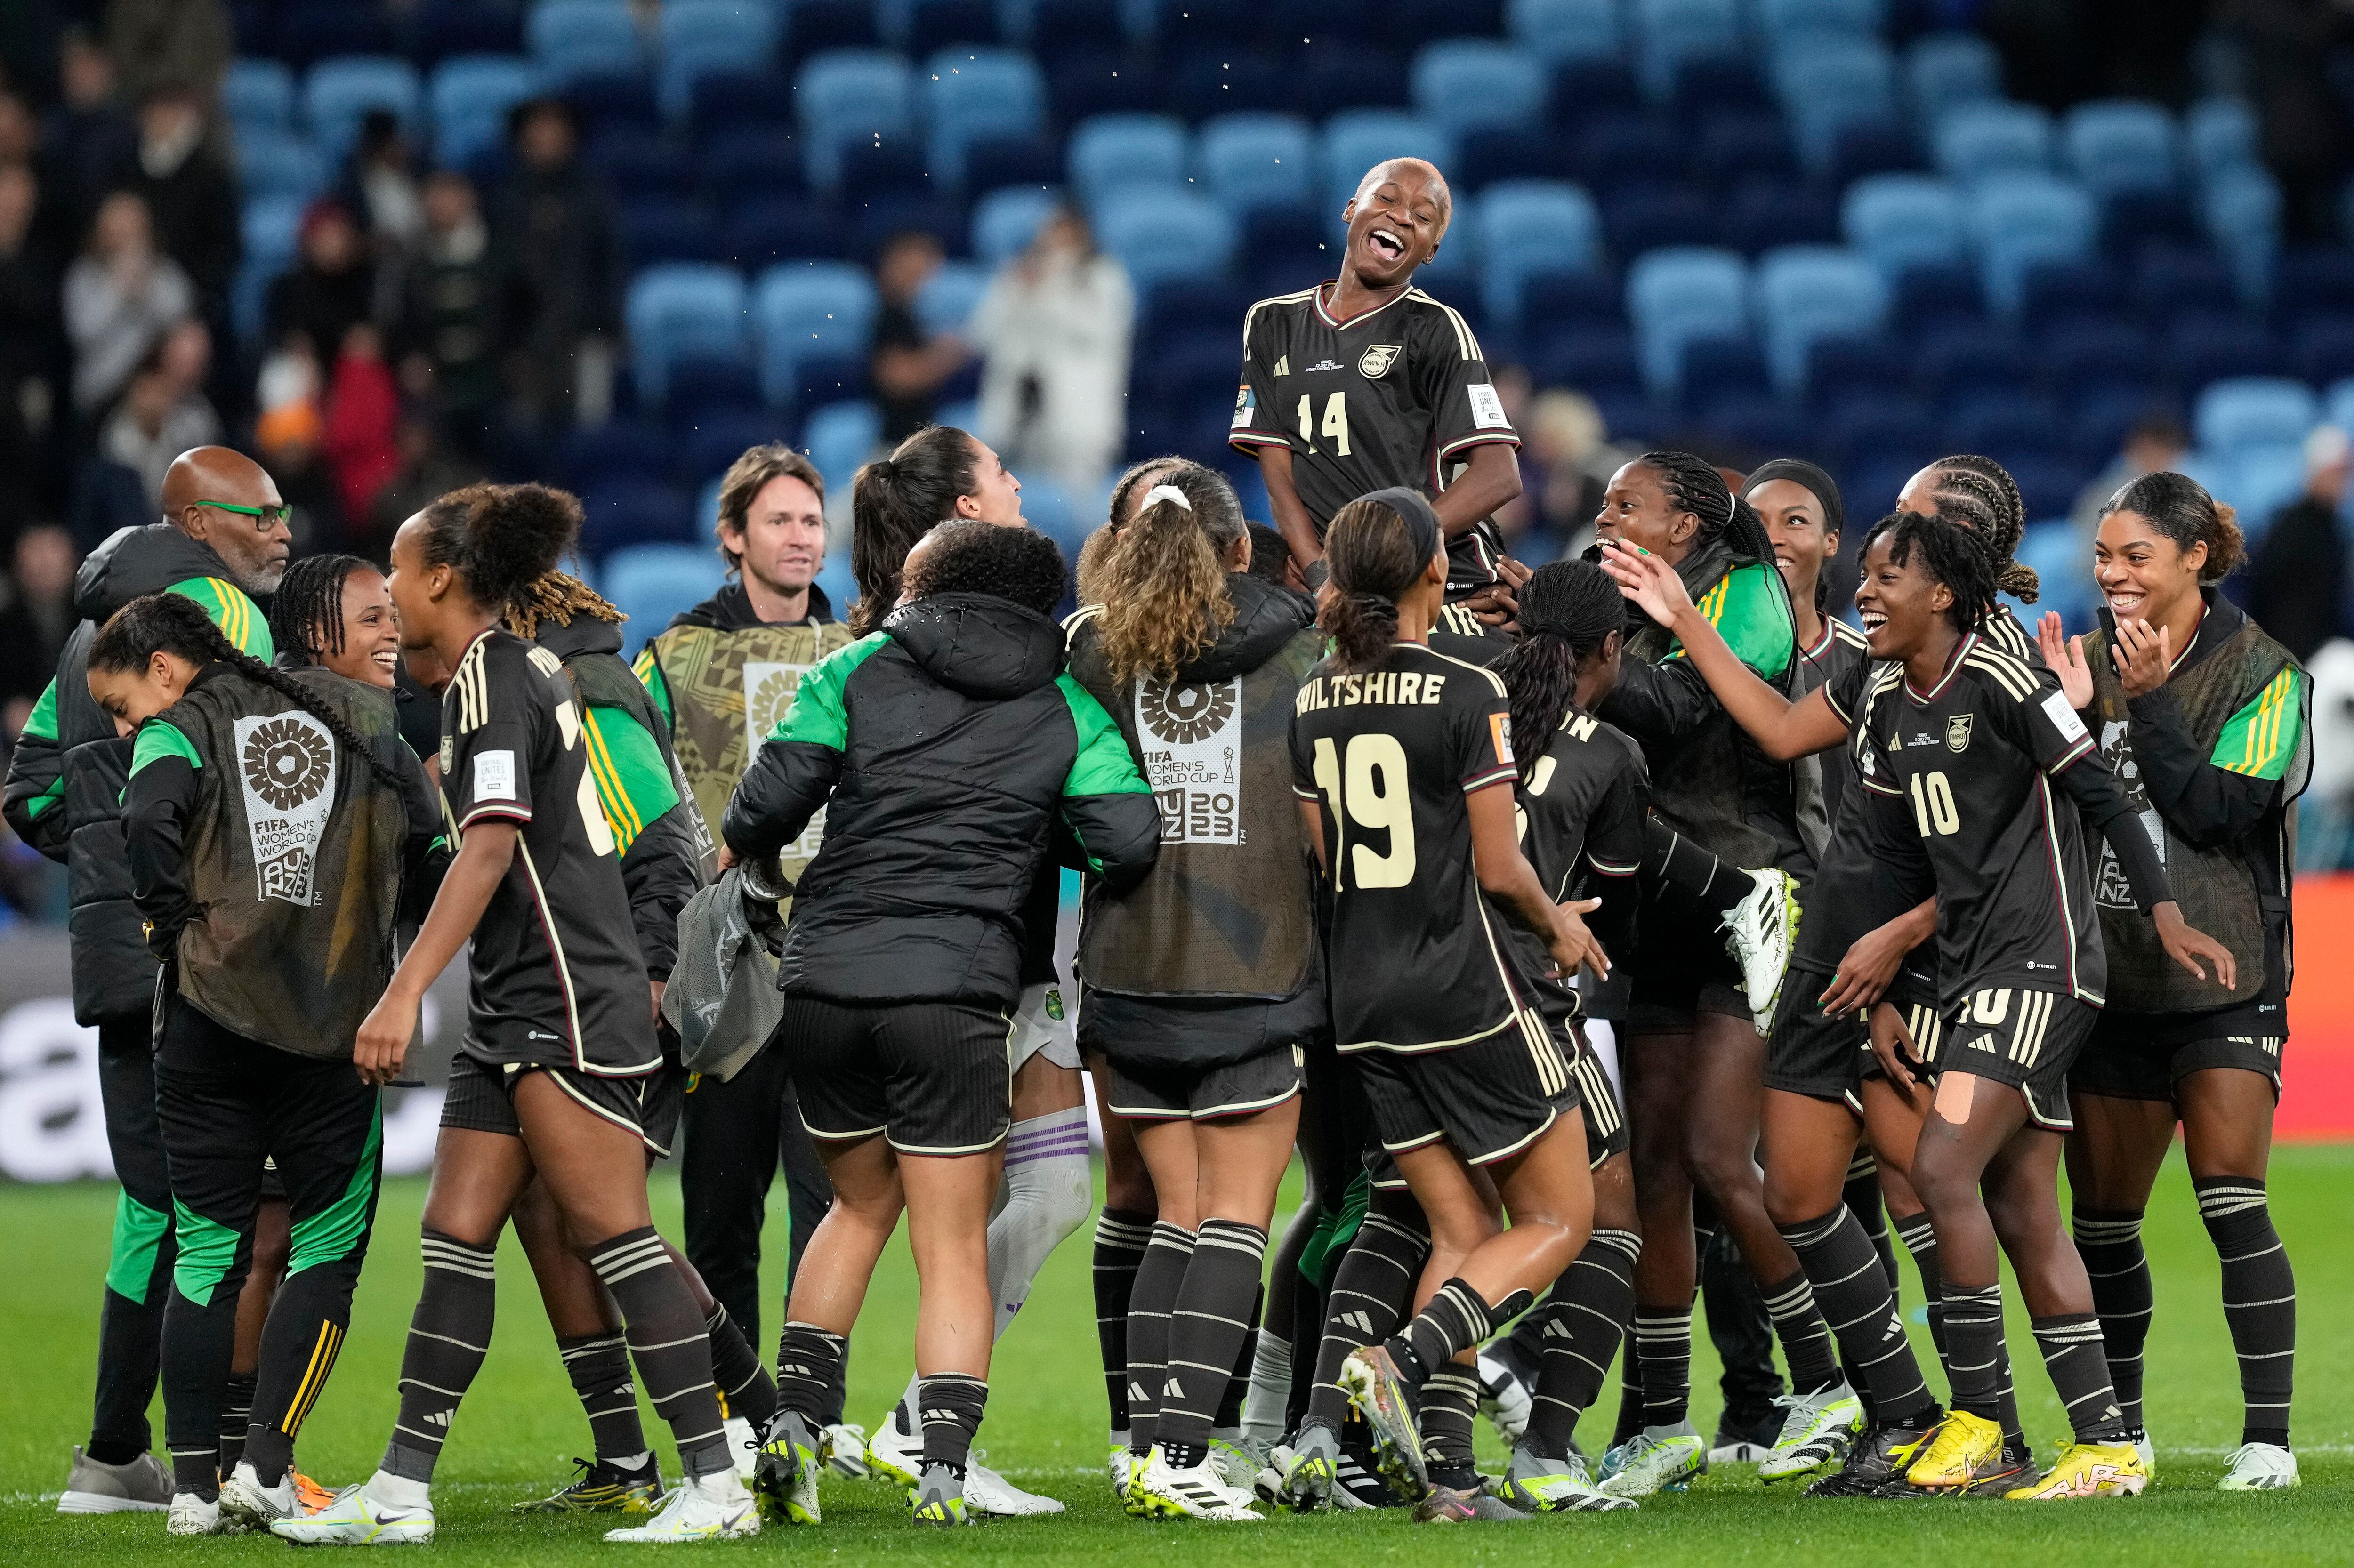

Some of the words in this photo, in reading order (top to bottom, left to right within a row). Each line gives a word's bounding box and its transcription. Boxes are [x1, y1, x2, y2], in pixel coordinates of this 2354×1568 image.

[1297, 392, 1351, 456] 14
[1296, 672, 1446, 718] WILTSHIRE
[481, 765, 505, 775] UNITES
[1150, 772, 1187, 786] ORLD
[1191, 772, 1218, 783] CUP
[1191, 793, 1234, 814] 20
[1313, 733, 1416, 893] 19
[1911, 771, 1959, 837] 10
[254, 819, 289, 834] FIFA
[257, 820, 314, 845] WOMEN'S
[1191, 816, 1233, 837] 23
[1240, 828, 1247, 846] TM
[259, 833, 305, 857] WORLD
[314, 891, 323, 908] TM
[1911, 972, 1931, 982] AEROREADY
